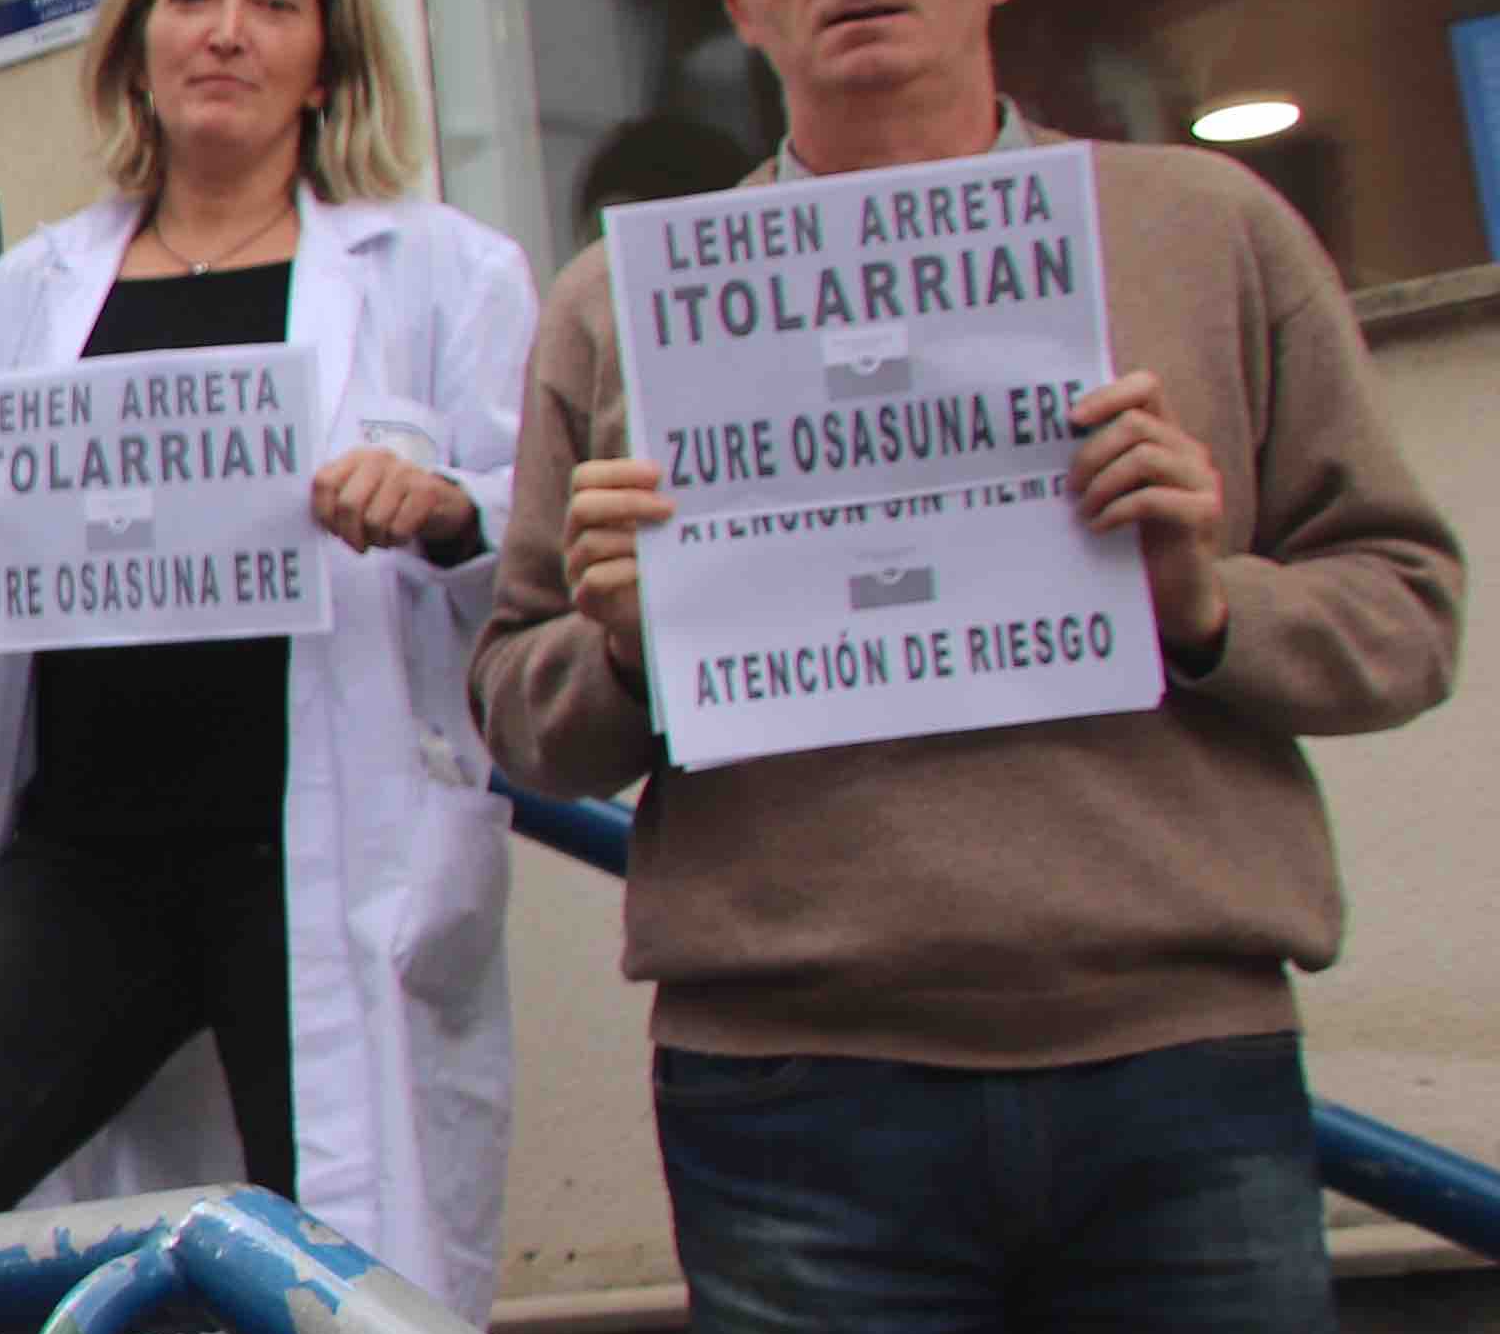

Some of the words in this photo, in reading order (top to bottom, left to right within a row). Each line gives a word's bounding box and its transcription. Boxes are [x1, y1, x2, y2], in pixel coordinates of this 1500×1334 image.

[666, 202, 821, 270] LEHEN
[861, 173, 1051, 247] ARRETA
[653, 236, 1074, 347] ITOLARRIAN
[122, 370, 279, 421] ARRETA
[669, 419, 777, 488] ZURE
[792, 393, 994, 471] OSASUNA
[1012, 379, 1092, 445] ERE
[57, 558, 220, 613] OSASUNA
[235, 549, 300, 603] ERE
[697, 633, 887, 706] ATENCIÓN
[906, 631, 952, 680] DE
[968, 612, 1112, 675] RIESGO
